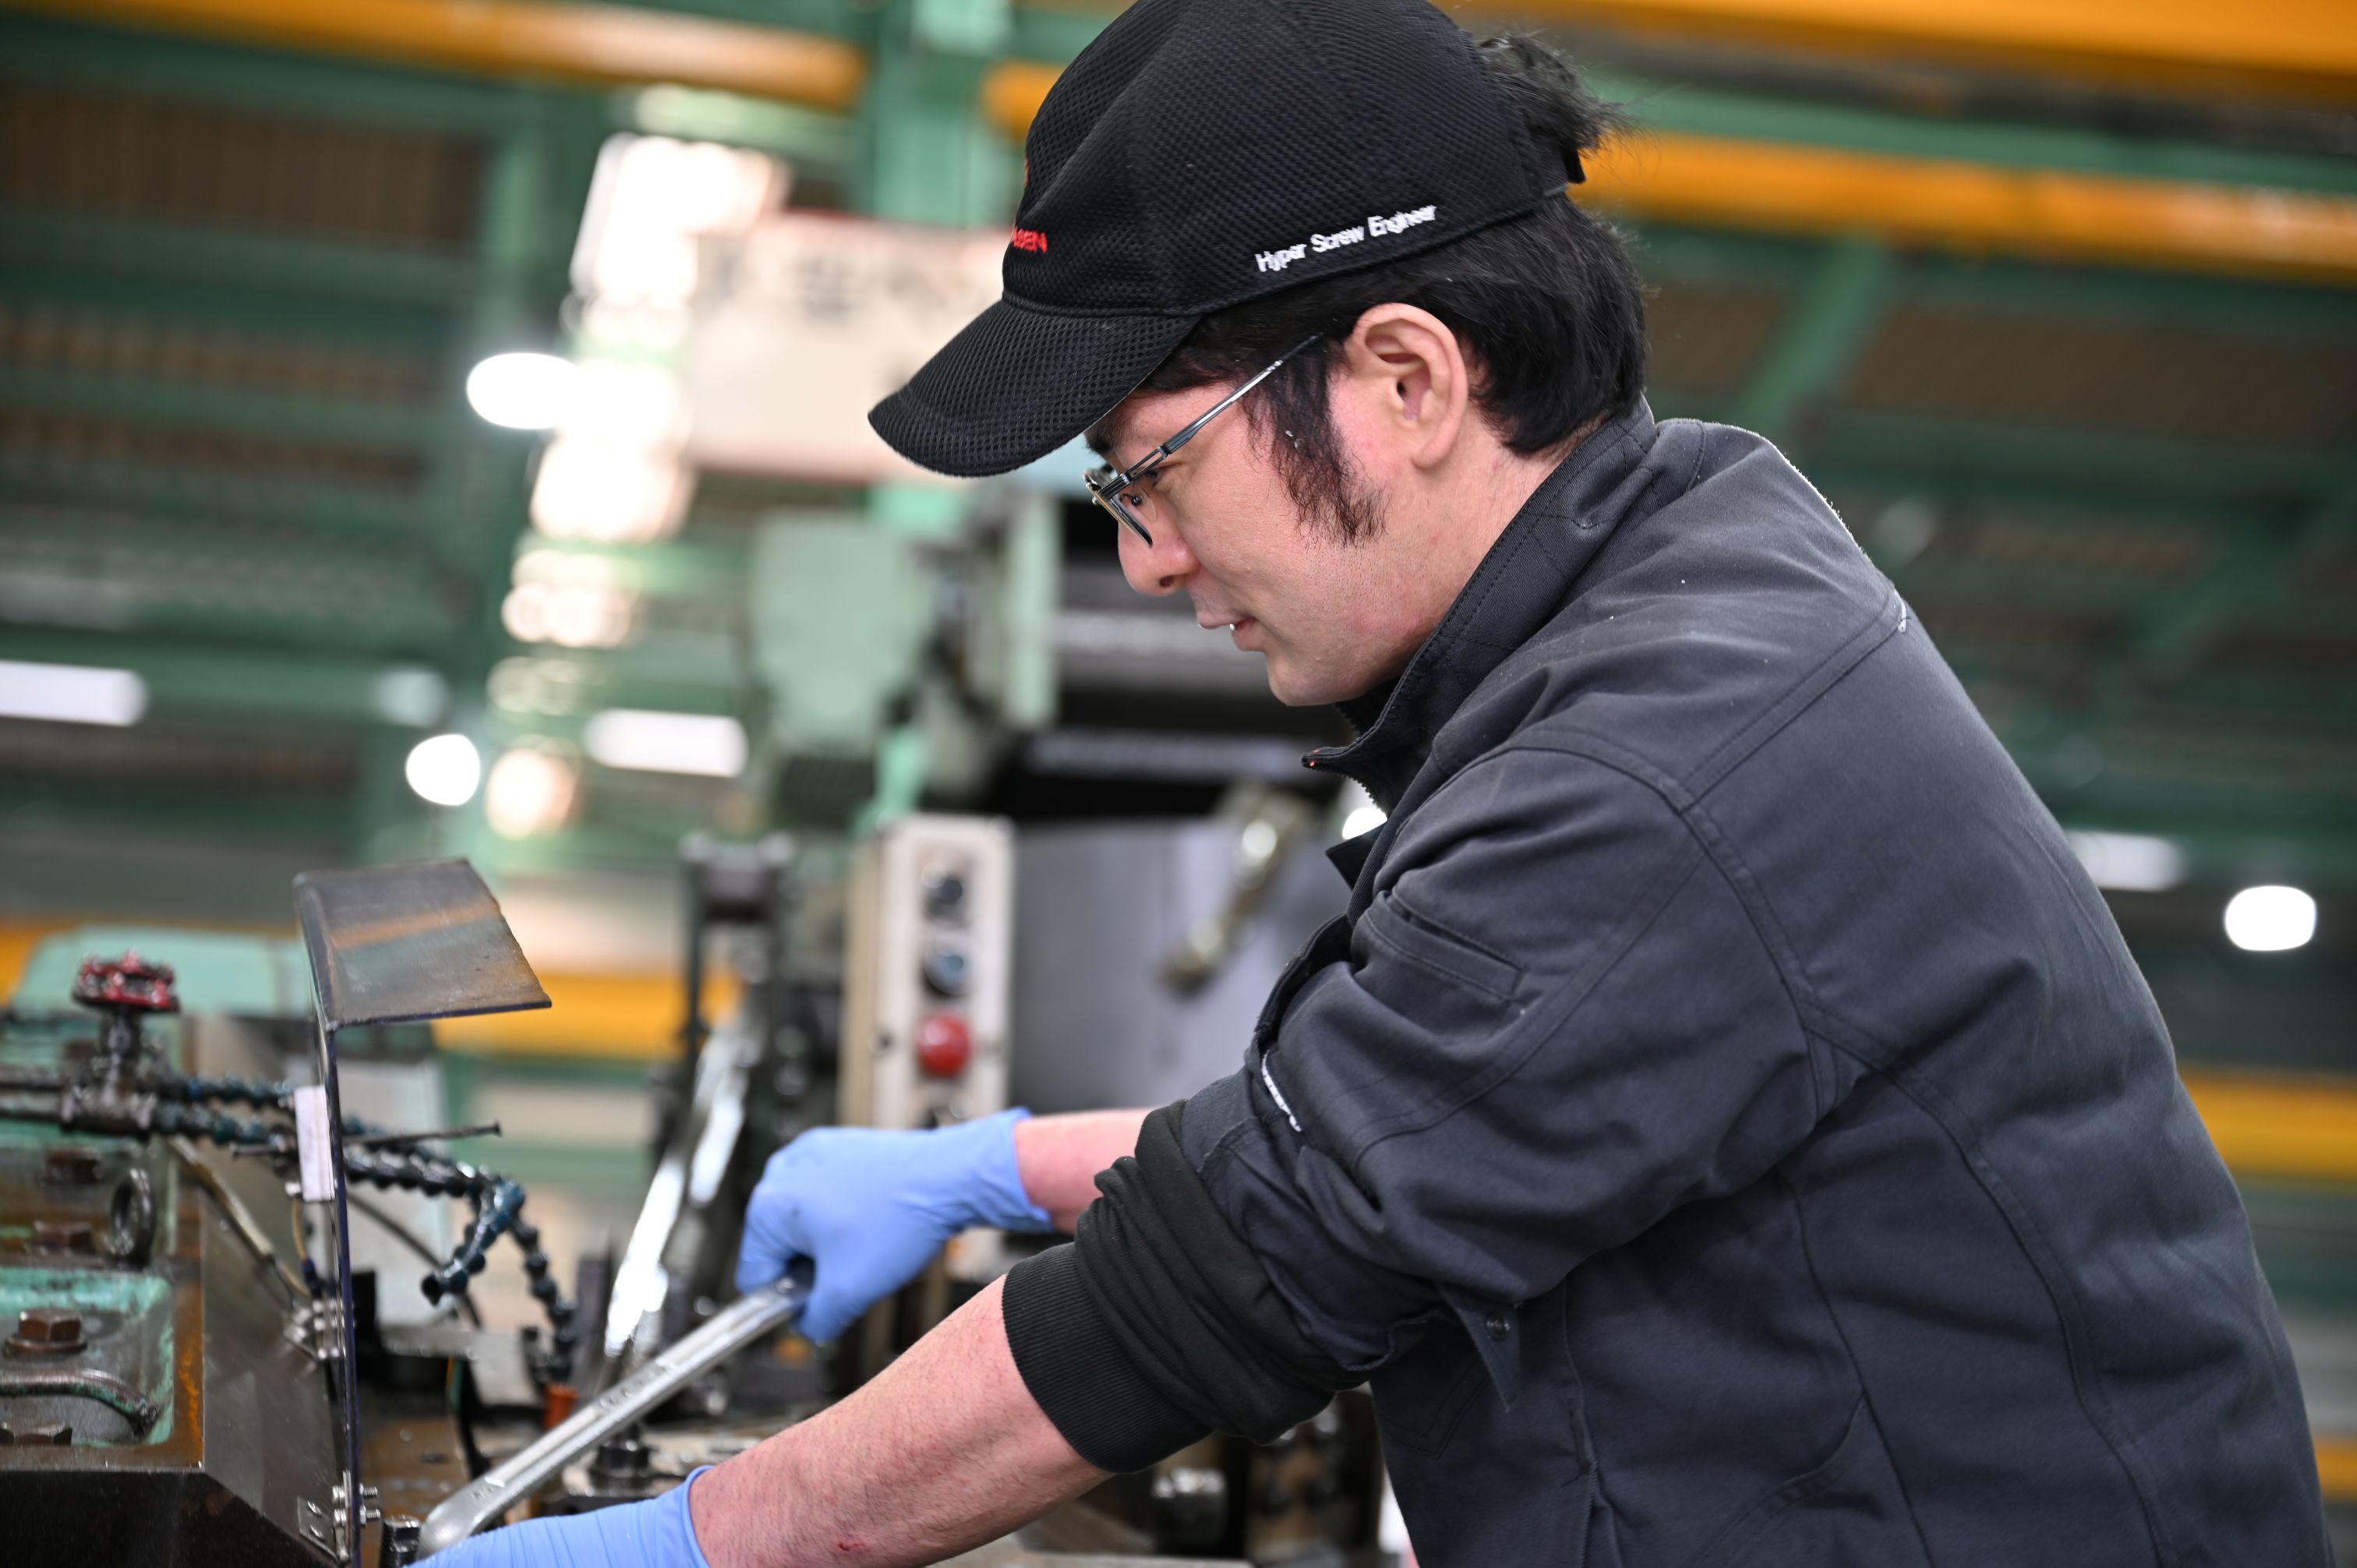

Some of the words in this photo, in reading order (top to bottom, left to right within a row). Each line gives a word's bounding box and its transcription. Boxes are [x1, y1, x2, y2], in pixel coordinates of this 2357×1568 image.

[1255, 244, 1307, 273] Hyper
[1310, 226, 1365, 253] Screw
[1367, 204, 1437, 237] Engineer
